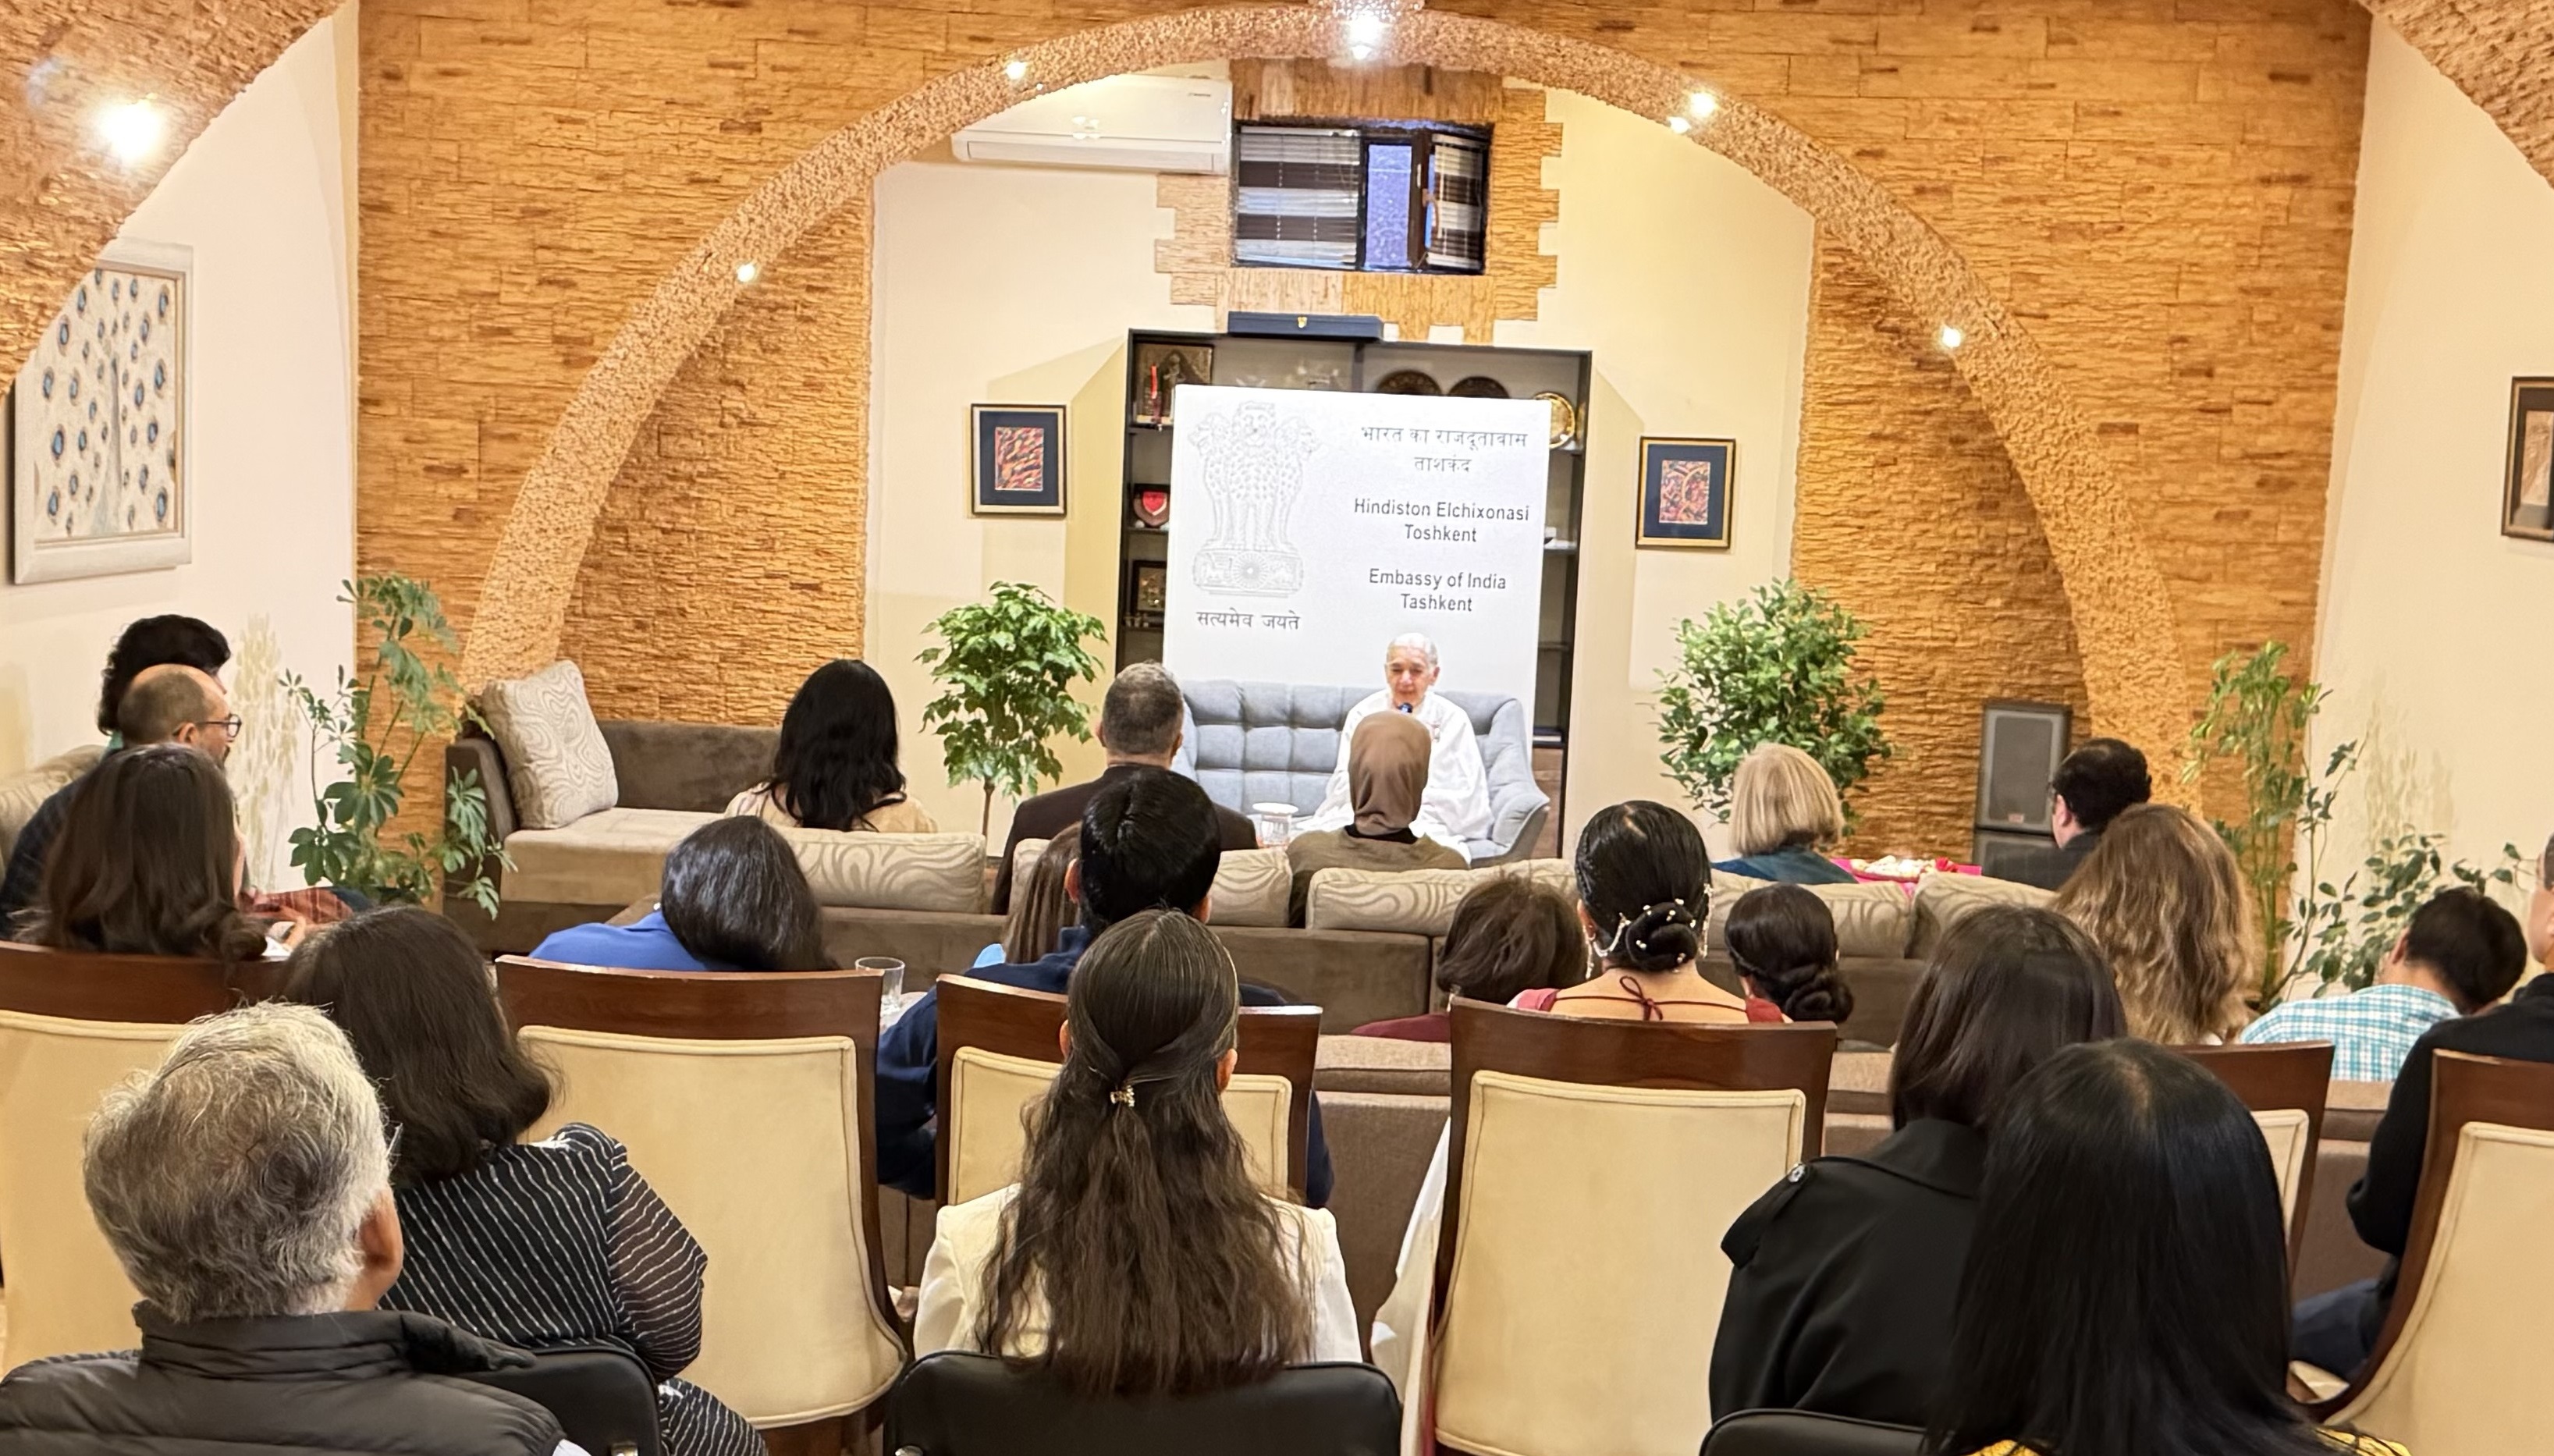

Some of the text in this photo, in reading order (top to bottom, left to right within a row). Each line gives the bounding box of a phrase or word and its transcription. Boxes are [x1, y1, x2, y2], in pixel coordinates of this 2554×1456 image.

[1362, 427, 1404, 442] भारत
[1409, 428, 1430, 443] का
[1354, 497, 1529, 521] Hindiston Elchixonasi
[1404, 523, 1477, 543] Toshkent
[1369, 567, 1506, 591] Embassy of India
[1400, 593, 1472, 613] Tashkent
[1195, 607, 1301, 630] सत्यमेव जयते
